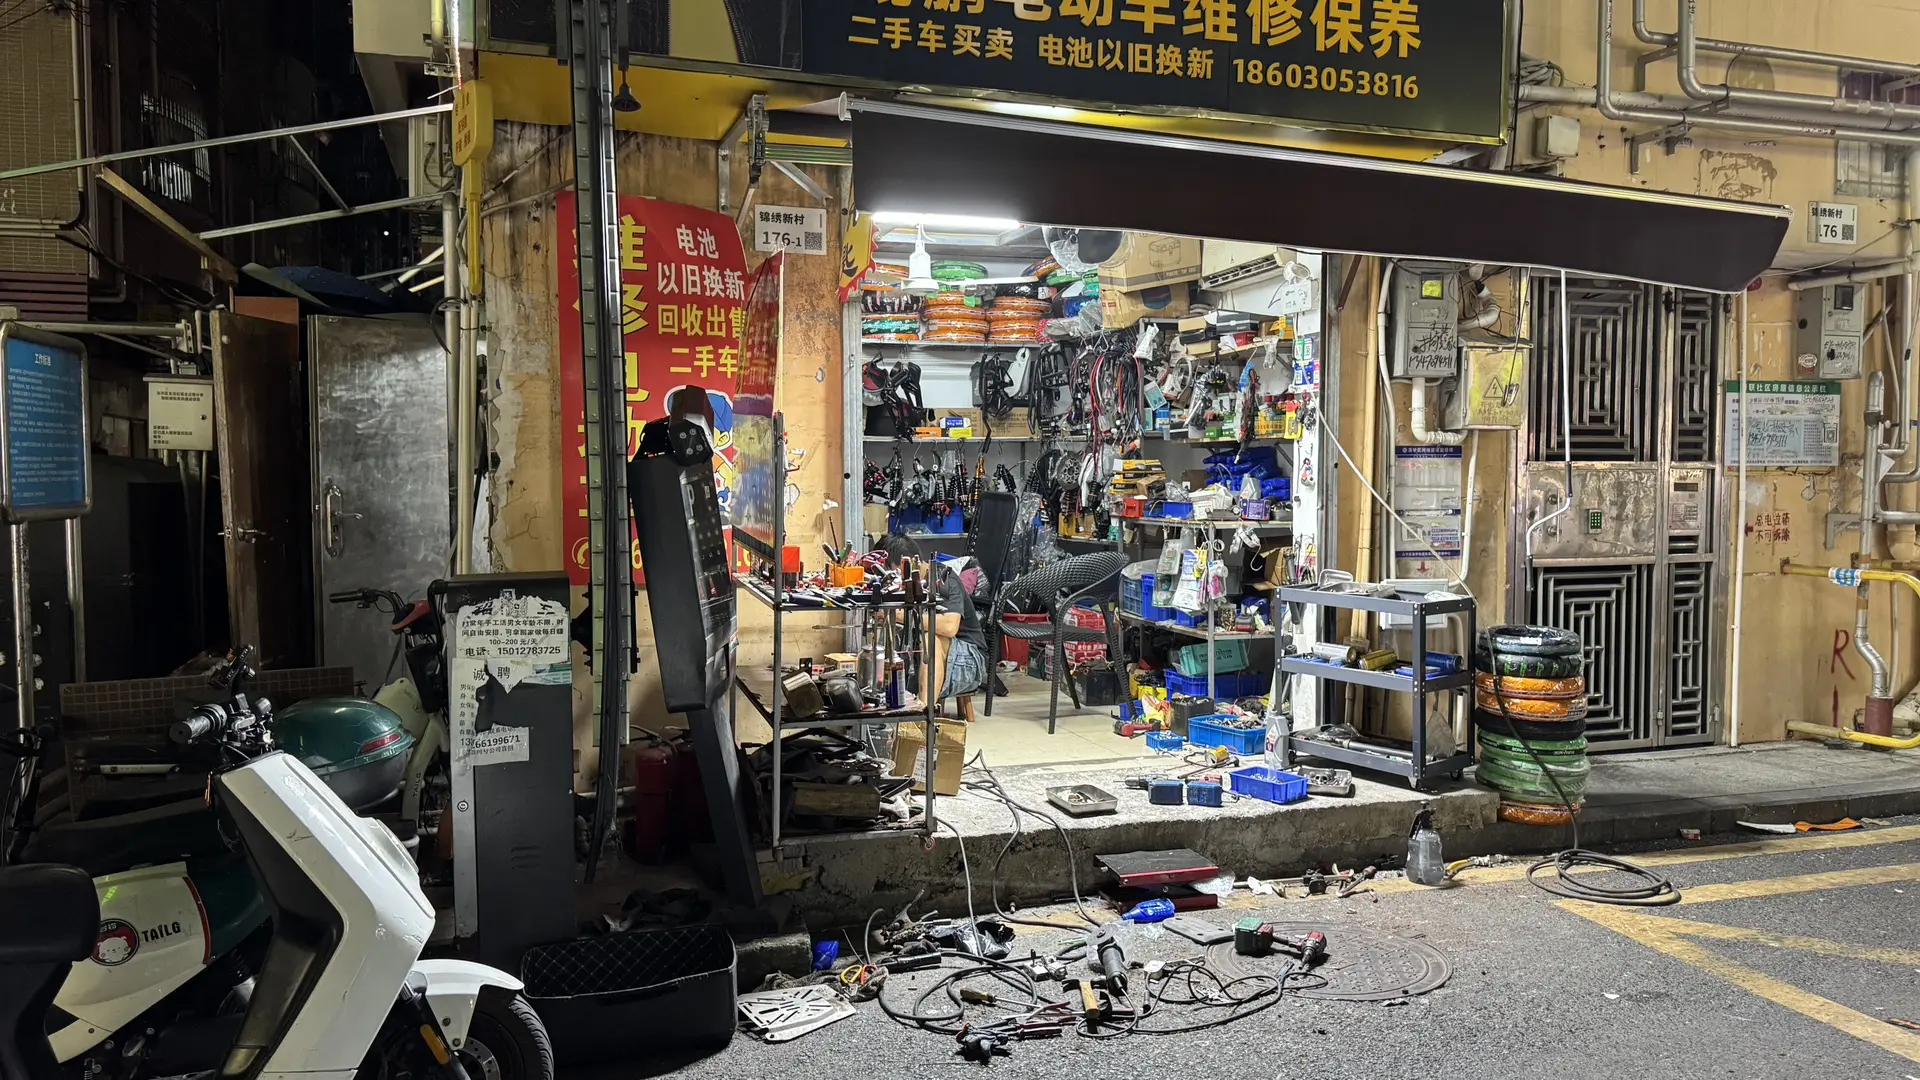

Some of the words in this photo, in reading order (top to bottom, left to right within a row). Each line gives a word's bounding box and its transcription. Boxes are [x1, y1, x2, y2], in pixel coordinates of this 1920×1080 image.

[877, 0, 1422, 58] 车维修保养
[848, 15, 1014, 61] 二手车买卖
[1038, 34, 1214, 80] 电池以旧换新
[1232, 58, 1419, 99] 18603053816
[759, 211, 805, 225] 锦绣新村
[676, 223, 720, 259] 电池
[762, 231, 802, 247] 176-1
[657, 262, 744, 300] 以旧换新
[657, 304, 746, 339] 回收出售
[669, 345, 738, 379] 二手车
[1746, 383, 1827, 393] 联社区房屋信息公示栏
[497, 646, 561, 657] 15012783725
[473, 668, 486, 682] 诚
[497, 666, 511, 680] 聘
[412, 772, 422, 799] TAILG
[142, 920, 182, 942] TAILG
